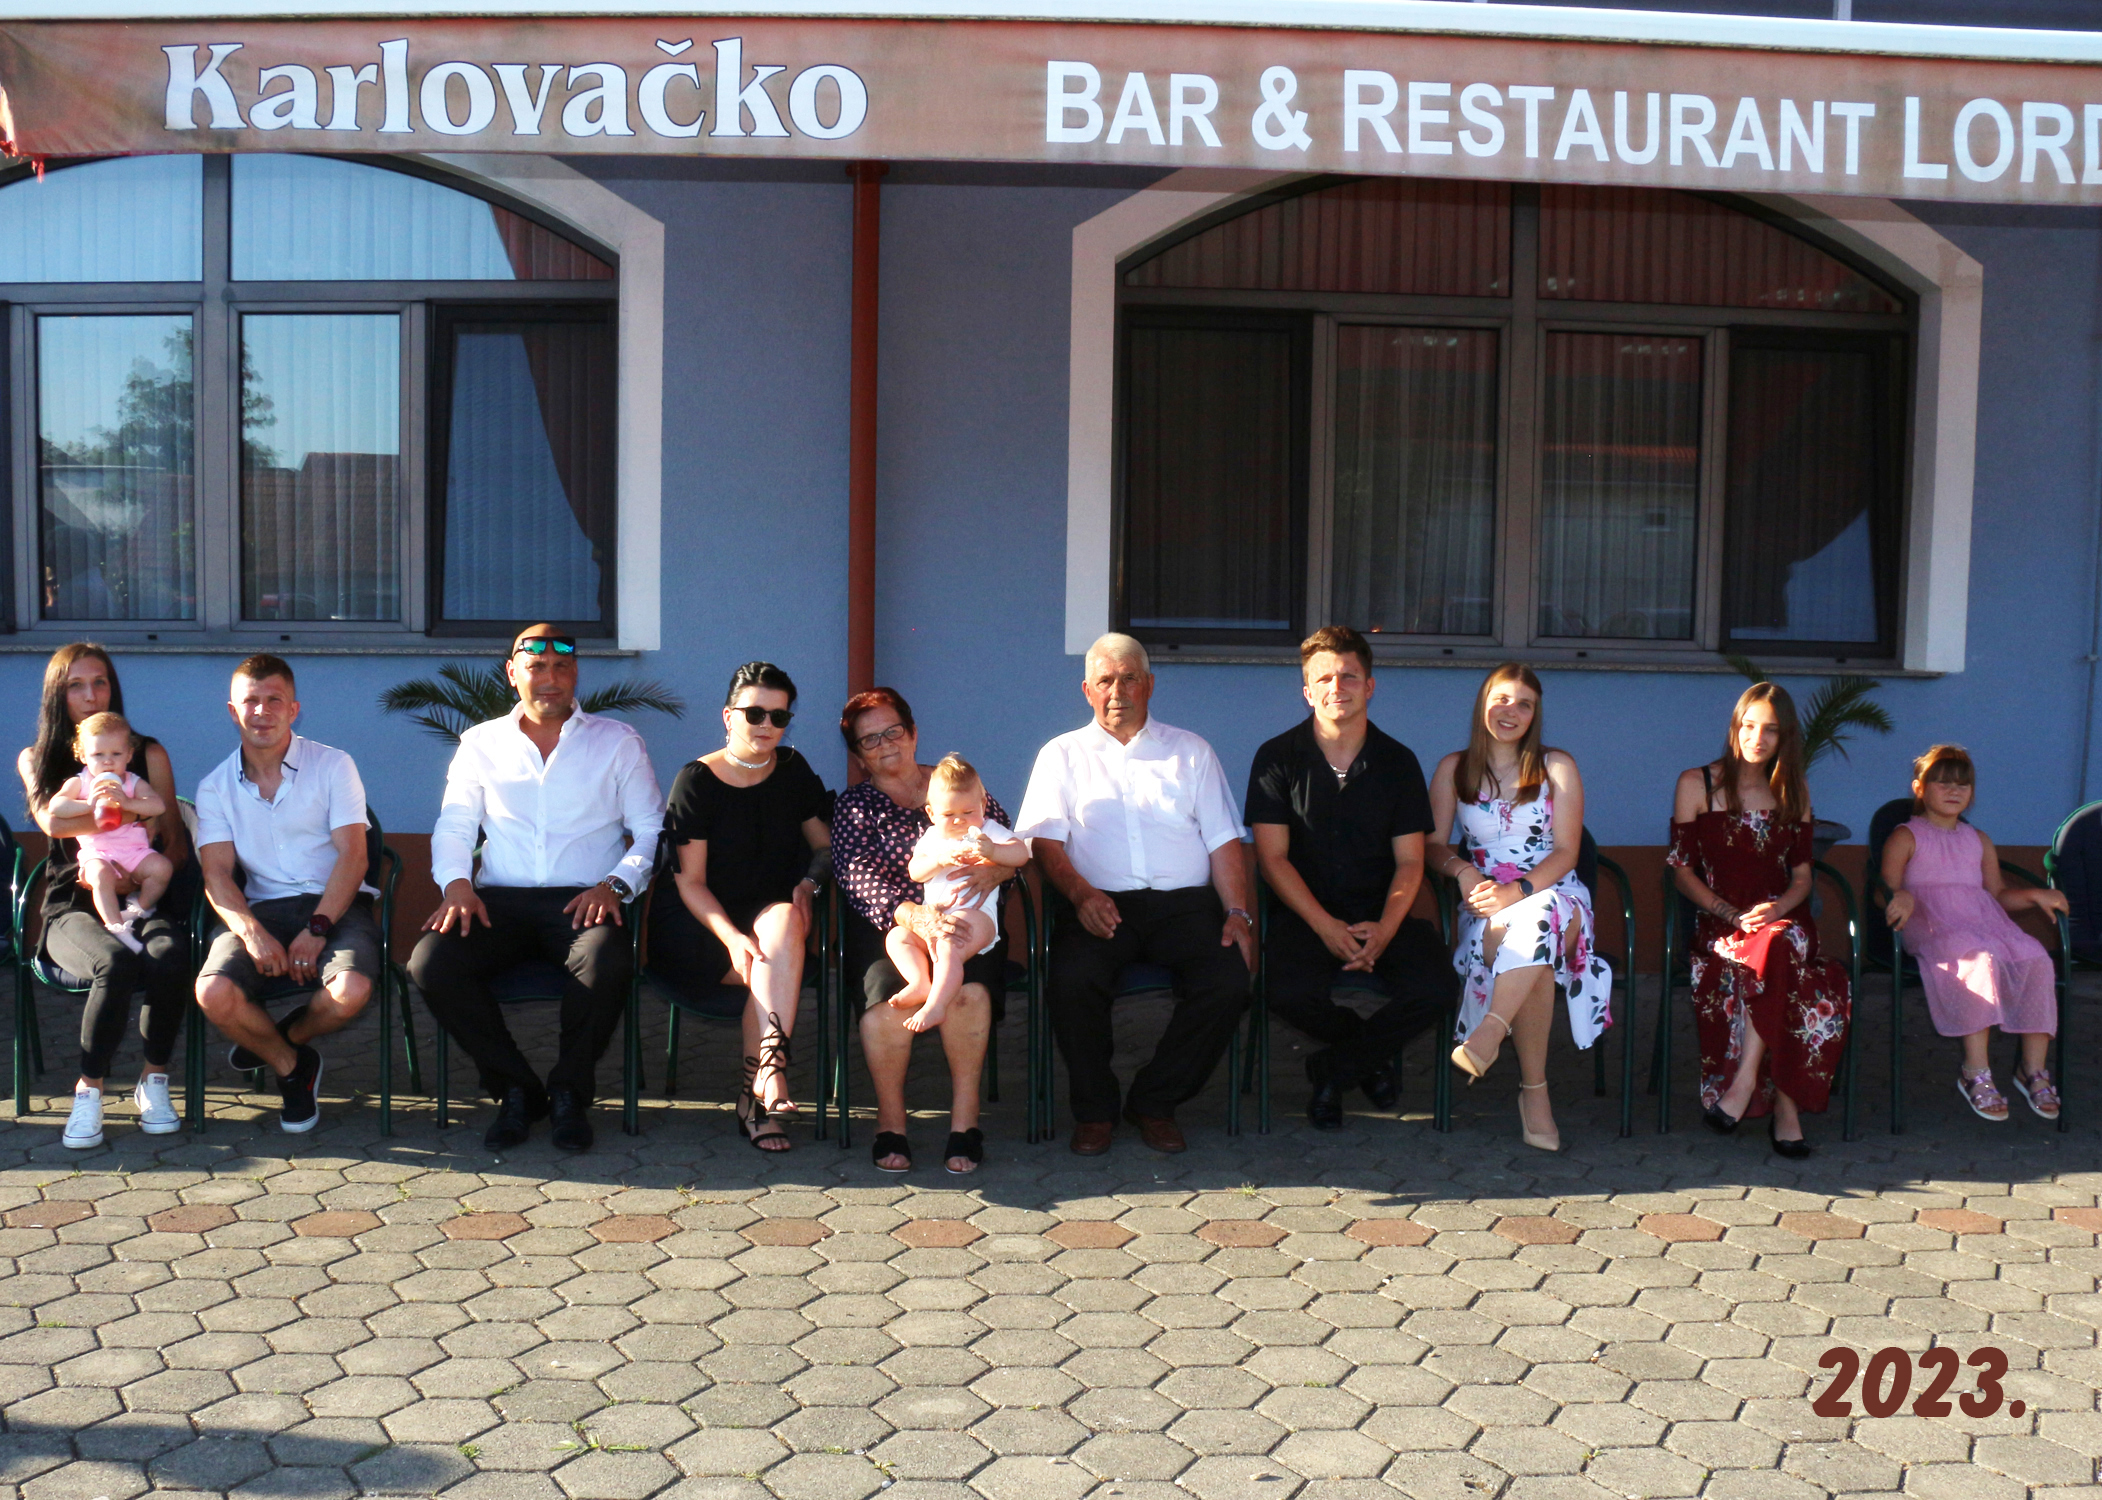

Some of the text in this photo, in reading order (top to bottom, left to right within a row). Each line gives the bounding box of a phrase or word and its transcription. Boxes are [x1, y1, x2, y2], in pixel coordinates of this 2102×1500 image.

[161, 37, 869, 140] Karlovačko
[1045, 60, 1223, 148] BAR
[1251, 65, 1313, 152] &
[1342, 69, 1876, 176] RESTAURANT
